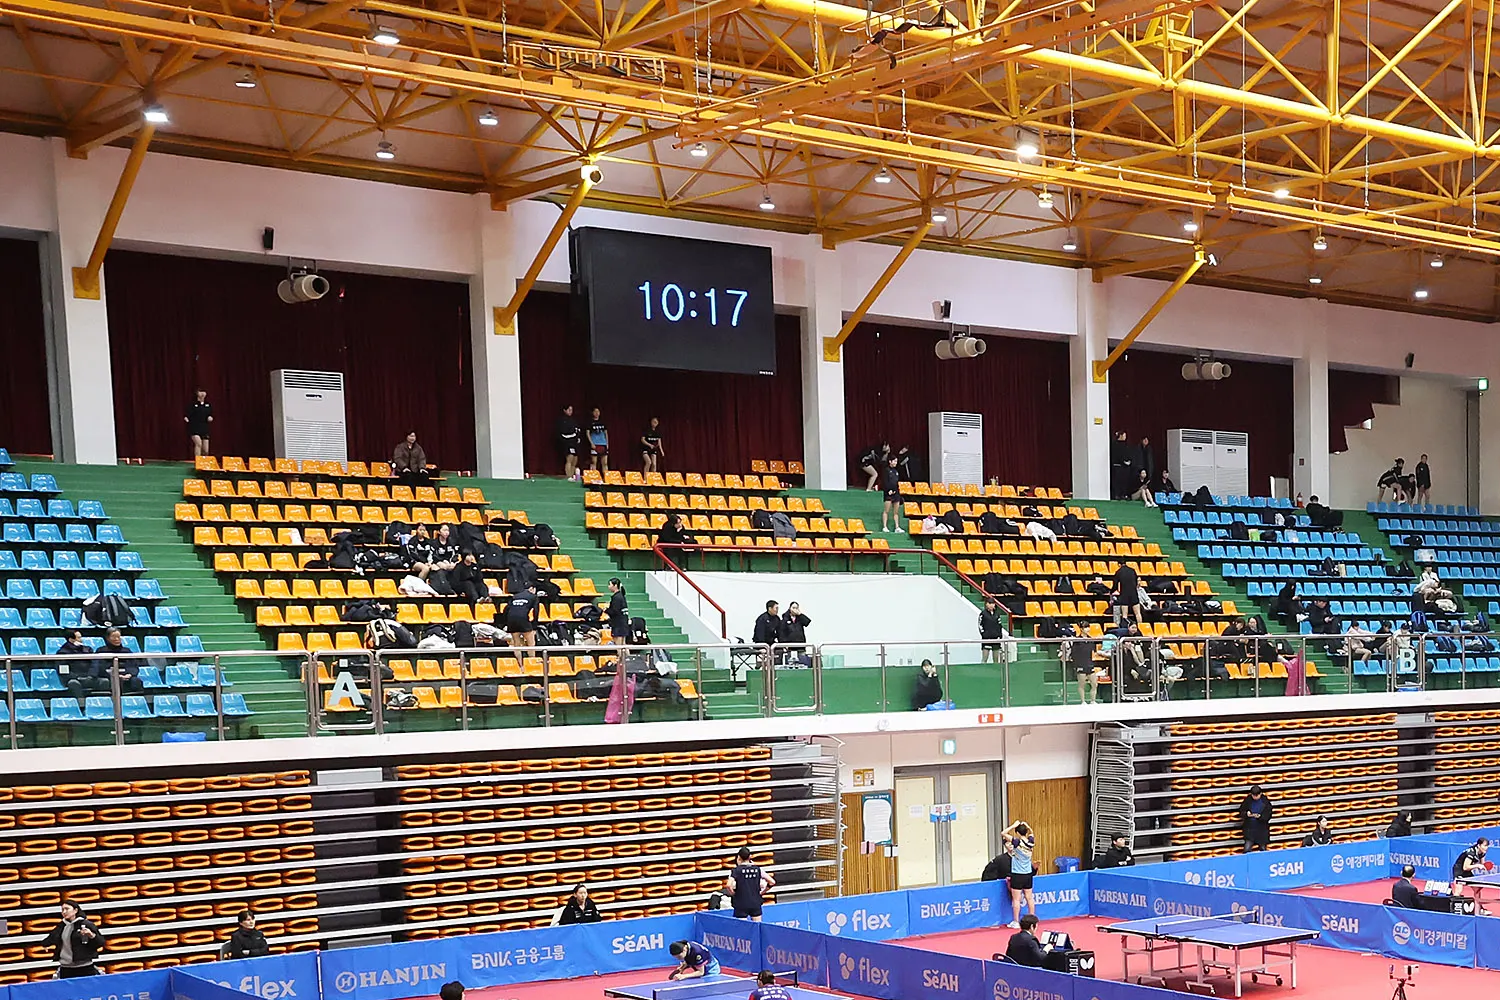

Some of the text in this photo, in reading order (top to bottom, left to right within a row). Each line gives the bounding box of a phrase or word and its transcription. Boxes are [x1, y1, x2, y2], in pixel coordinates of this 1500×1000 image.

[639, 281, 748, 327] 10:17
[1398, 648, 1416, 672] B
[328, 670, 363, 706] A
[1345, 853, 1385, 868] 애경케미칼
[1390, 852, 1440, 868] KOREAN AIR
[1204, 870, 1235, 887] flex
[1056, 888, 1080, 902] AIR
[1094, 889, 1147, 908] KOREAN AIR
[921, 898, 990, 919] BNK 금융그룹
[852, 909, 892, 931] flex
[736, 936, 752, 954] AIR
[1414, 928, 1467, 950] 애경케미칼
[472, 945, 565, 970] BNK 금융그룹
[777, 948, 819, 972] HANJIN
[360, 963, 446, 987] HANJIN
[859, 958, 890, 986] flex
[240, 976, 297, 1000] flex
